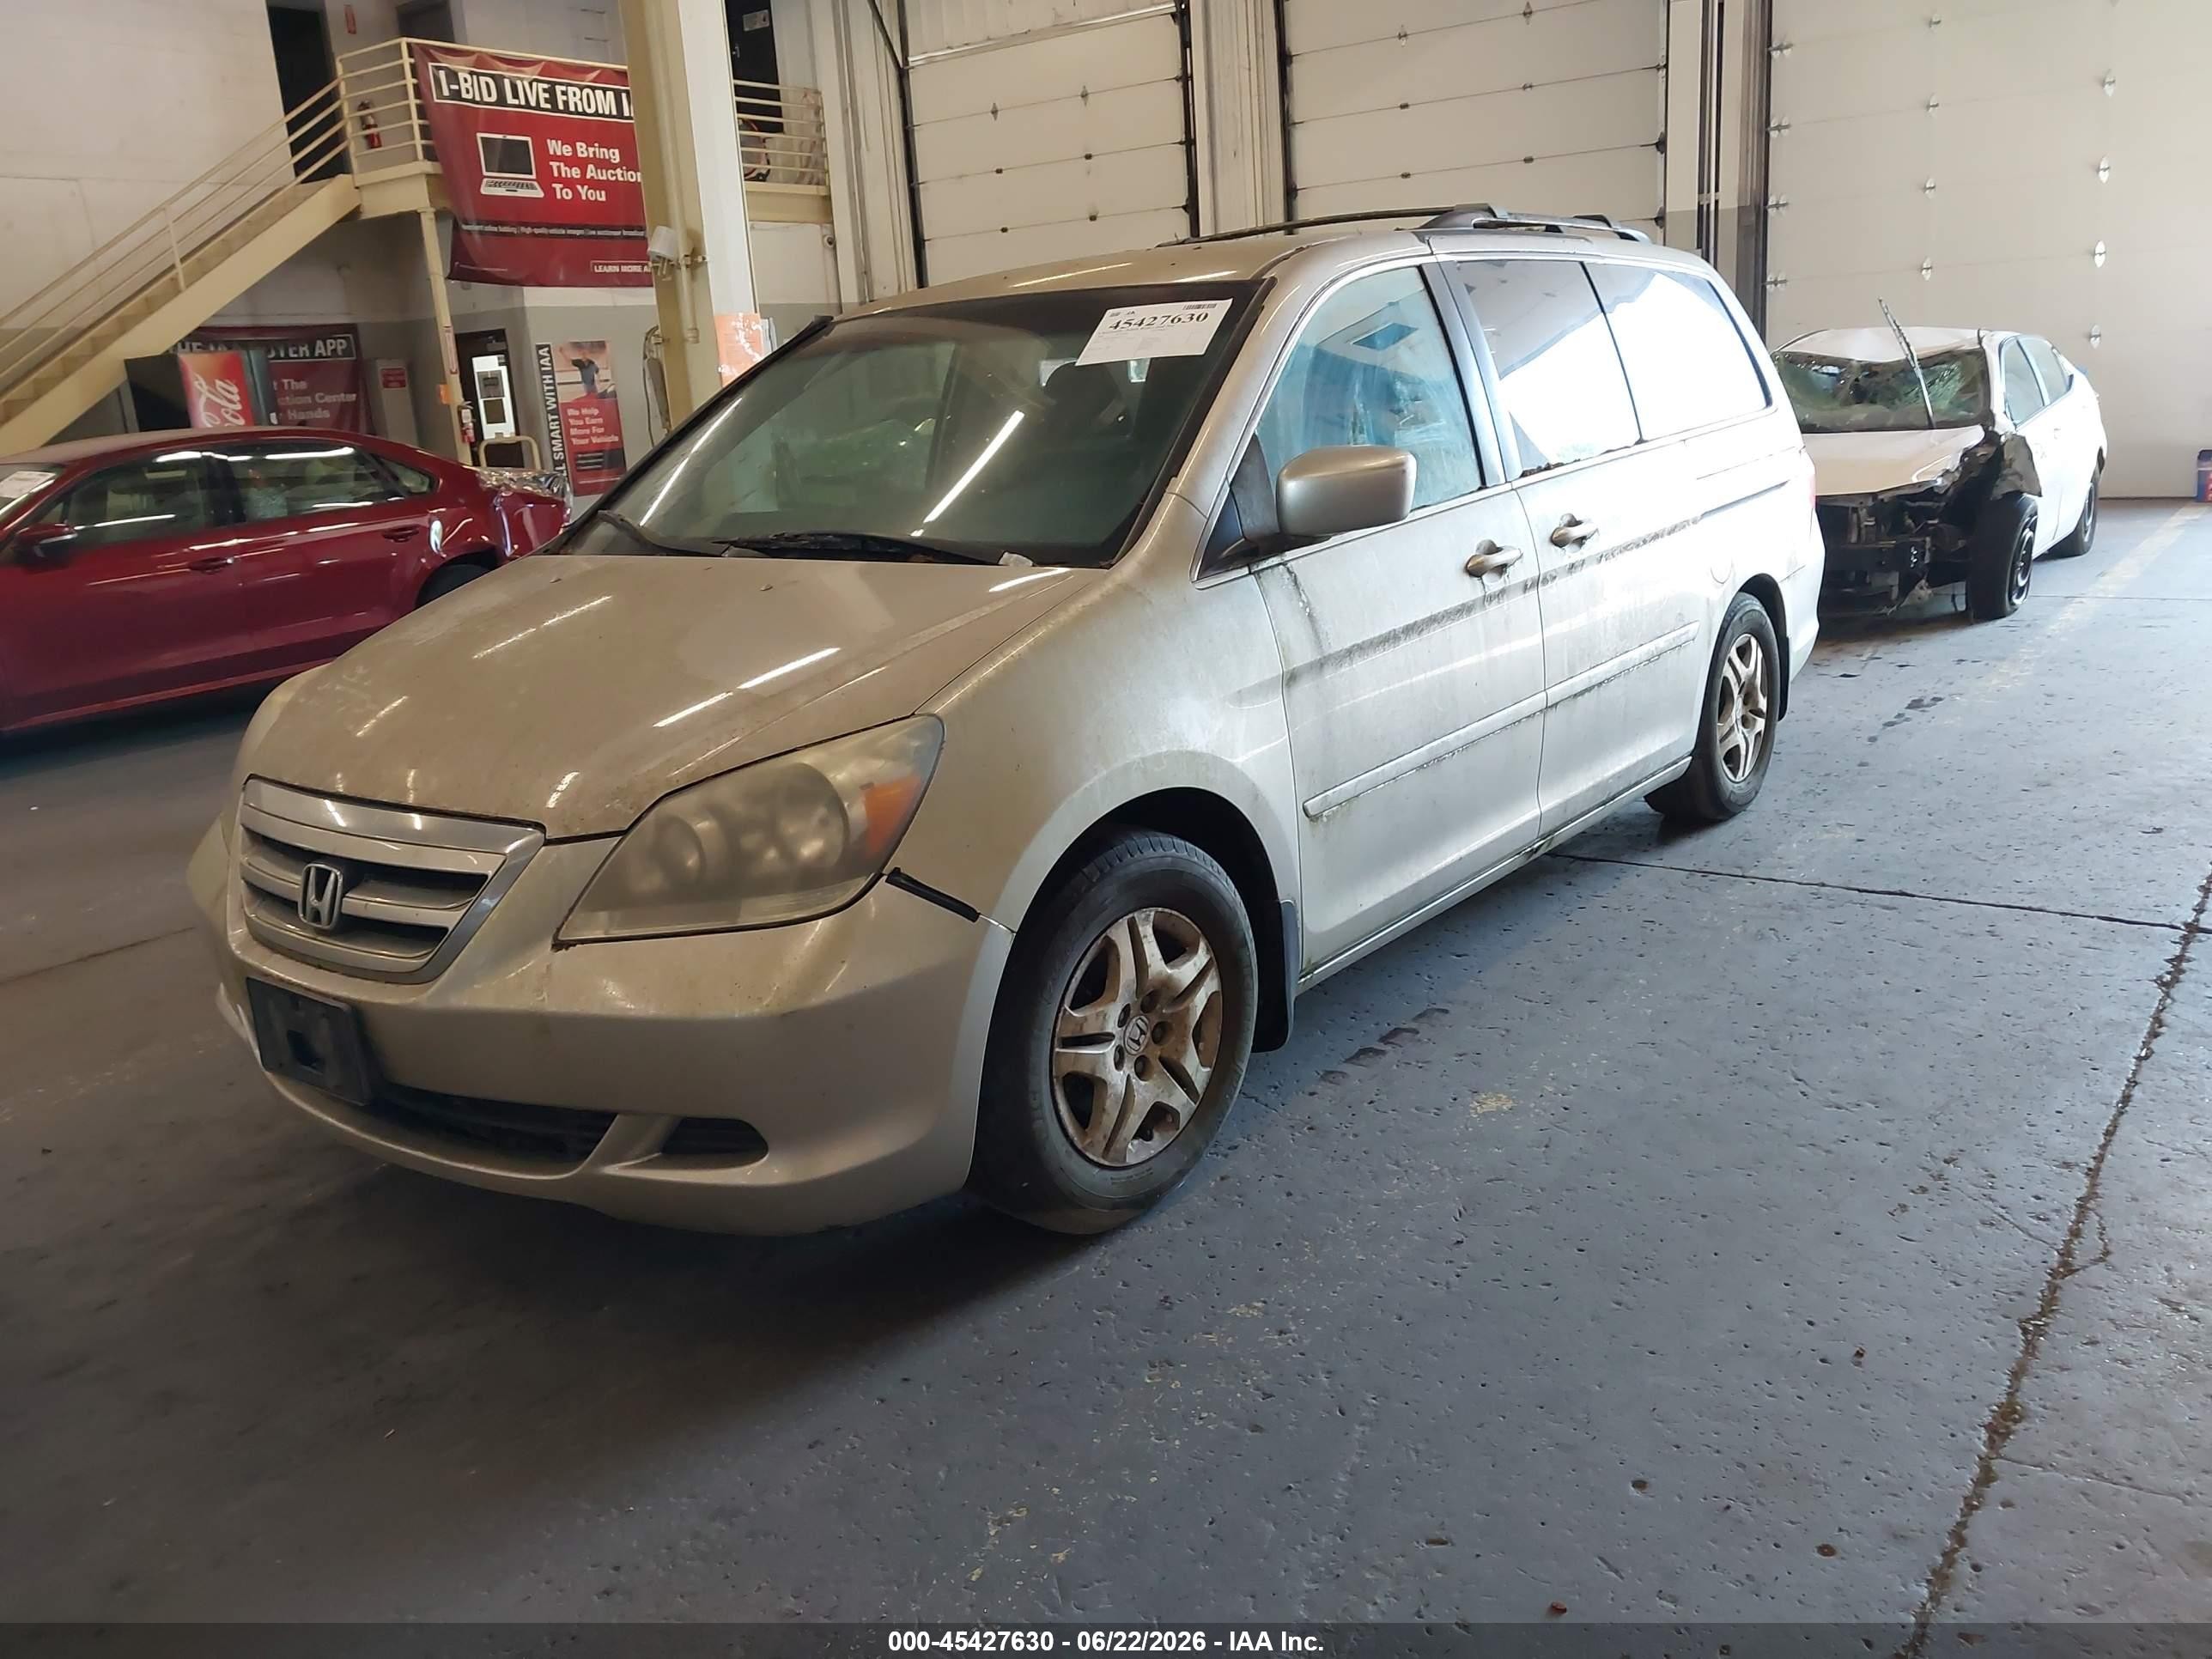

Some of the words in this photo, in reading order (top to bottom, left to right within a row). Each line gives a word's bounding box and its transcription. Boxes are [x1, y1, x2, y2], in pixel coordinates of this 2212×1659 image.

[438, 70, 498, 102] I-BID
[504, 78, 551, 109] LIVE
[556, 85, 617, 116] FROM
[547, 138, 573, 157] We
[575, 142, 620, 162] Bring
[550, 161, 580, 179] The
[552, 184, 572, 200] To
[577, 185, 606, 202] You
[1109, 312, 1209, 331] 45427630
[314, 339, 348, 357] APP
[538, 347, 552, 371] IAA
[543, 374, 557, 410] WITH
[548, 413, 565, 460] SMART
